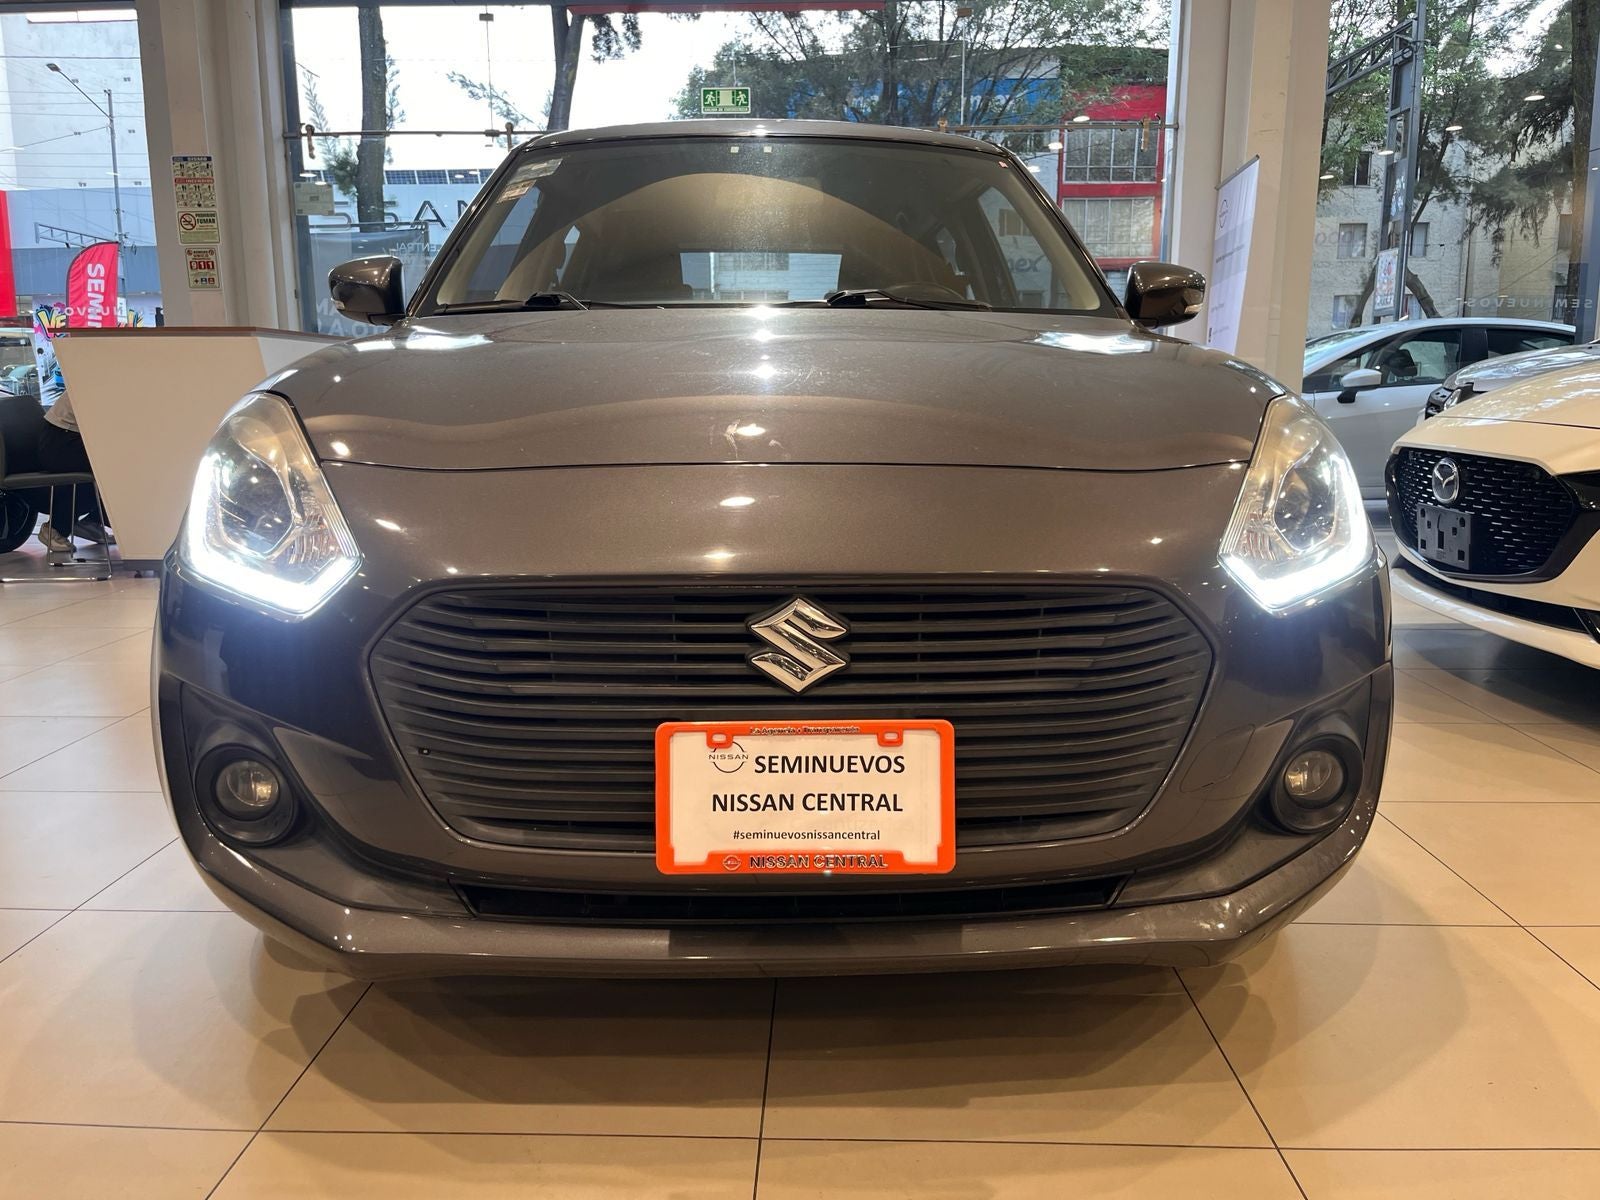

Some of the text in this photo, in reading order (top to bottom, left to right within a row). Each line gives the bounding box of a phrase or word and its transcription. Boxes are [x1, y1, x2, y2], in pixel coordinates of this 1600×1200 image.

[191, 260, 214, 270] 911
[754, 755, 906, 774] SEMINUEVOS
[712, 792, 904, 812] NISSAN CENTRAL
[733, 829, 881, 840] #seminuevosnissancentral
[749, 854, 888, 869] NISSAN CENTRAL
